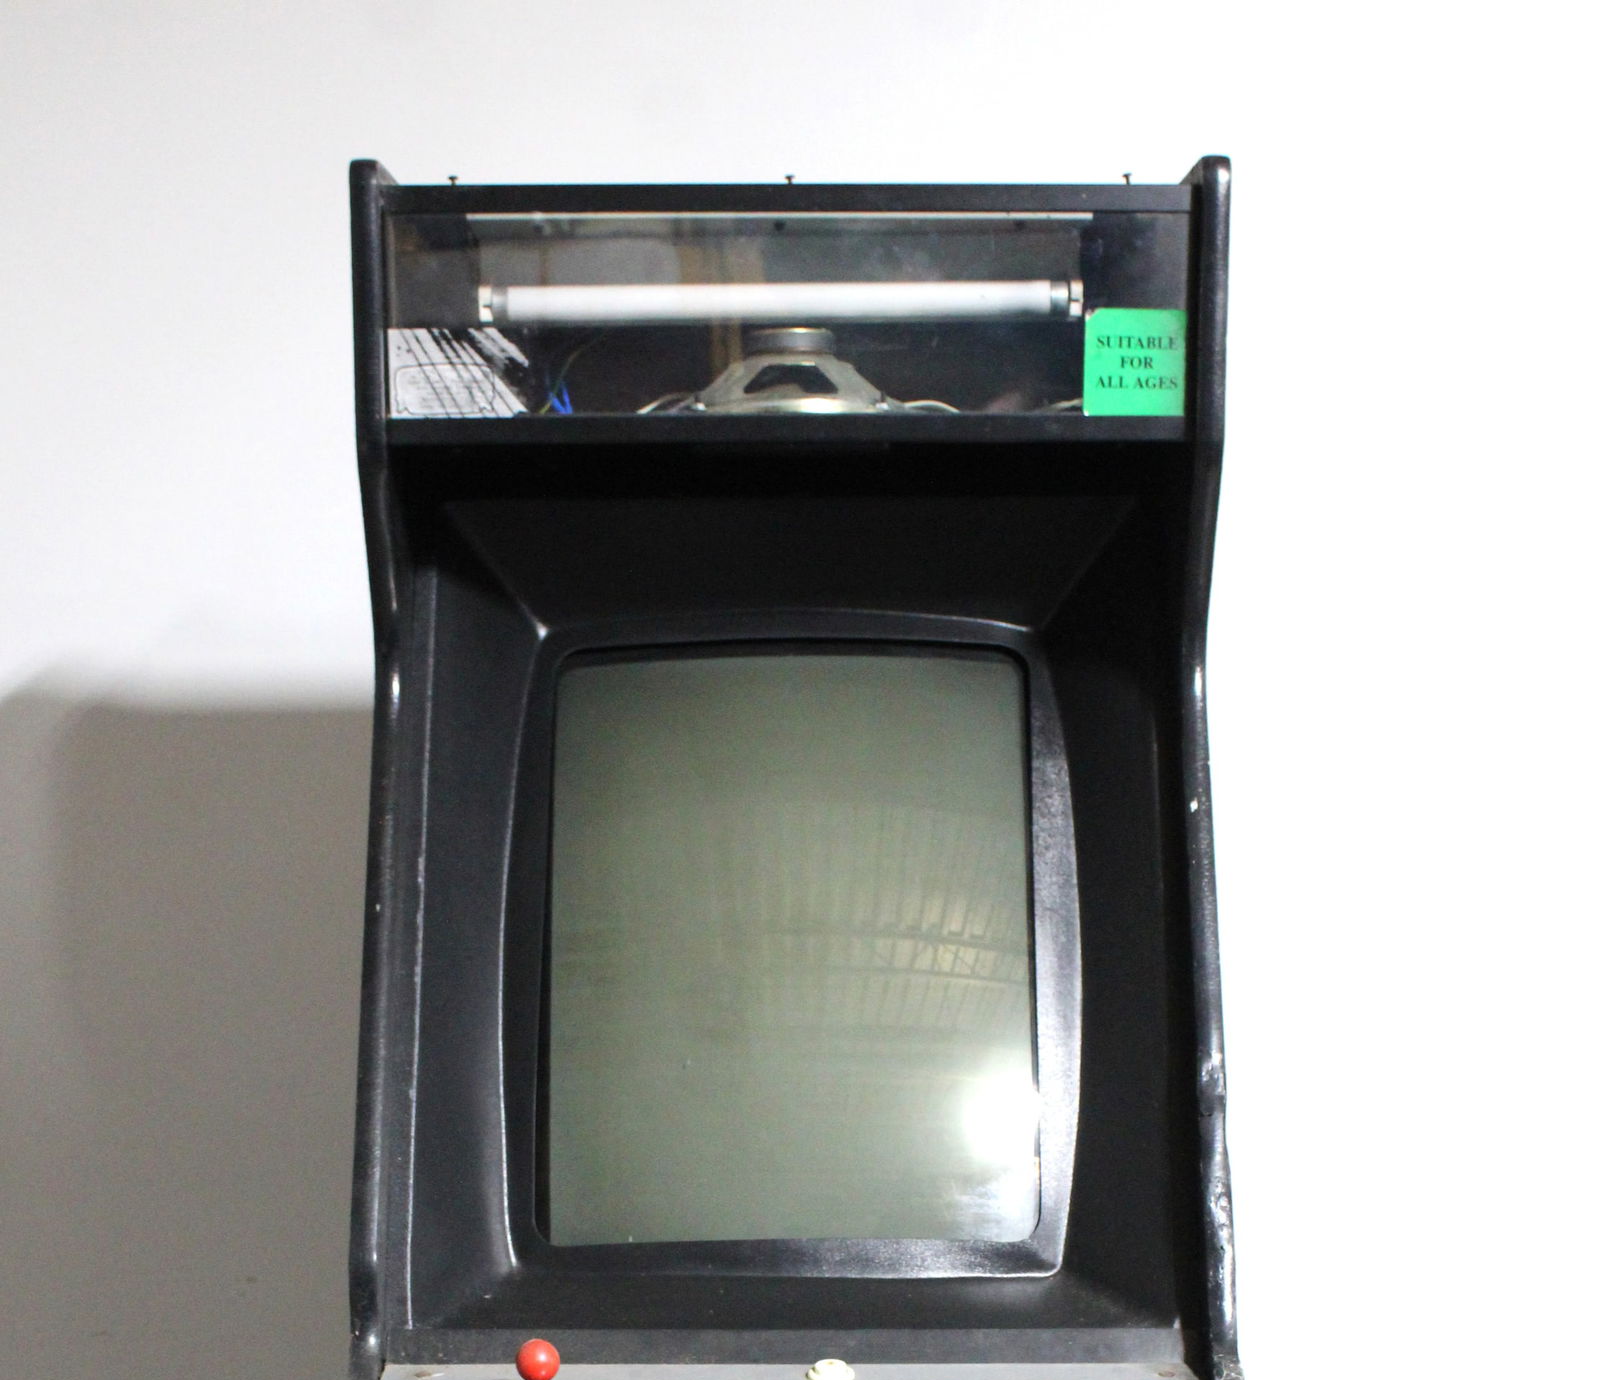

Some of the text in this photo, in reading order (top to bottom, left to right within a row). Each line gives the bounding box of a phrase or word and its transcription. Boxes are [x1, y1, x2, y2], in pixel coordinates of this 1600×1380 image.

[1096, 336, 1178, 350] SUITABLE
[1120, 356, 1153, 369] FOR
[1096, 376, 1178, 389] ALL AGES
